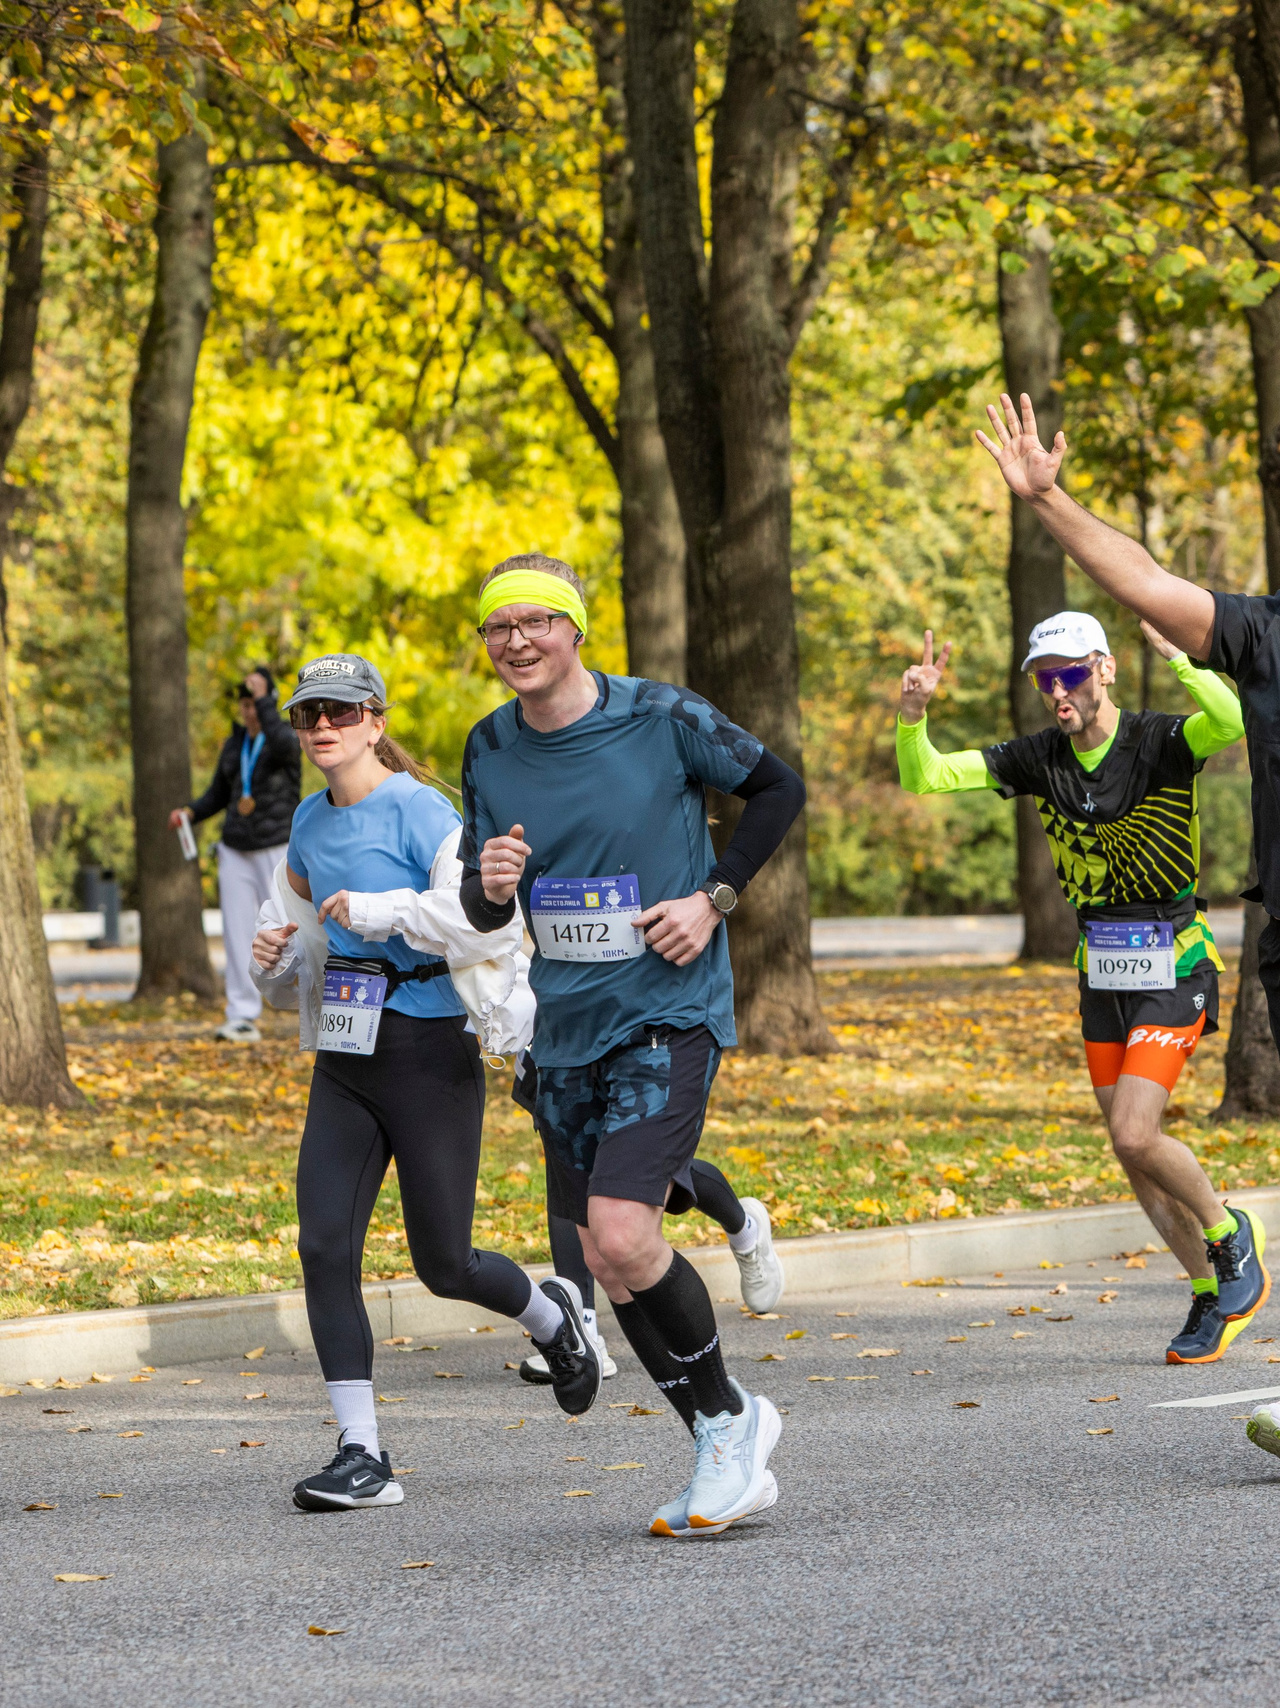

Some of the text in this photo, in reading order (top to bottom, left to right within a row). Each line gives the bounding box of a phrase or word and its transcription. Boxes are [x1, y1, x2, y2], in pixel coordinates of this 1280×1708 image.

[587, 894, 598, 904] D
[550, 923, 610, 942] 14172
[1131, 934, 1140, 944] C
[1097, 959, 1152, 974] 10979
[342, 987, 349, 998] E
